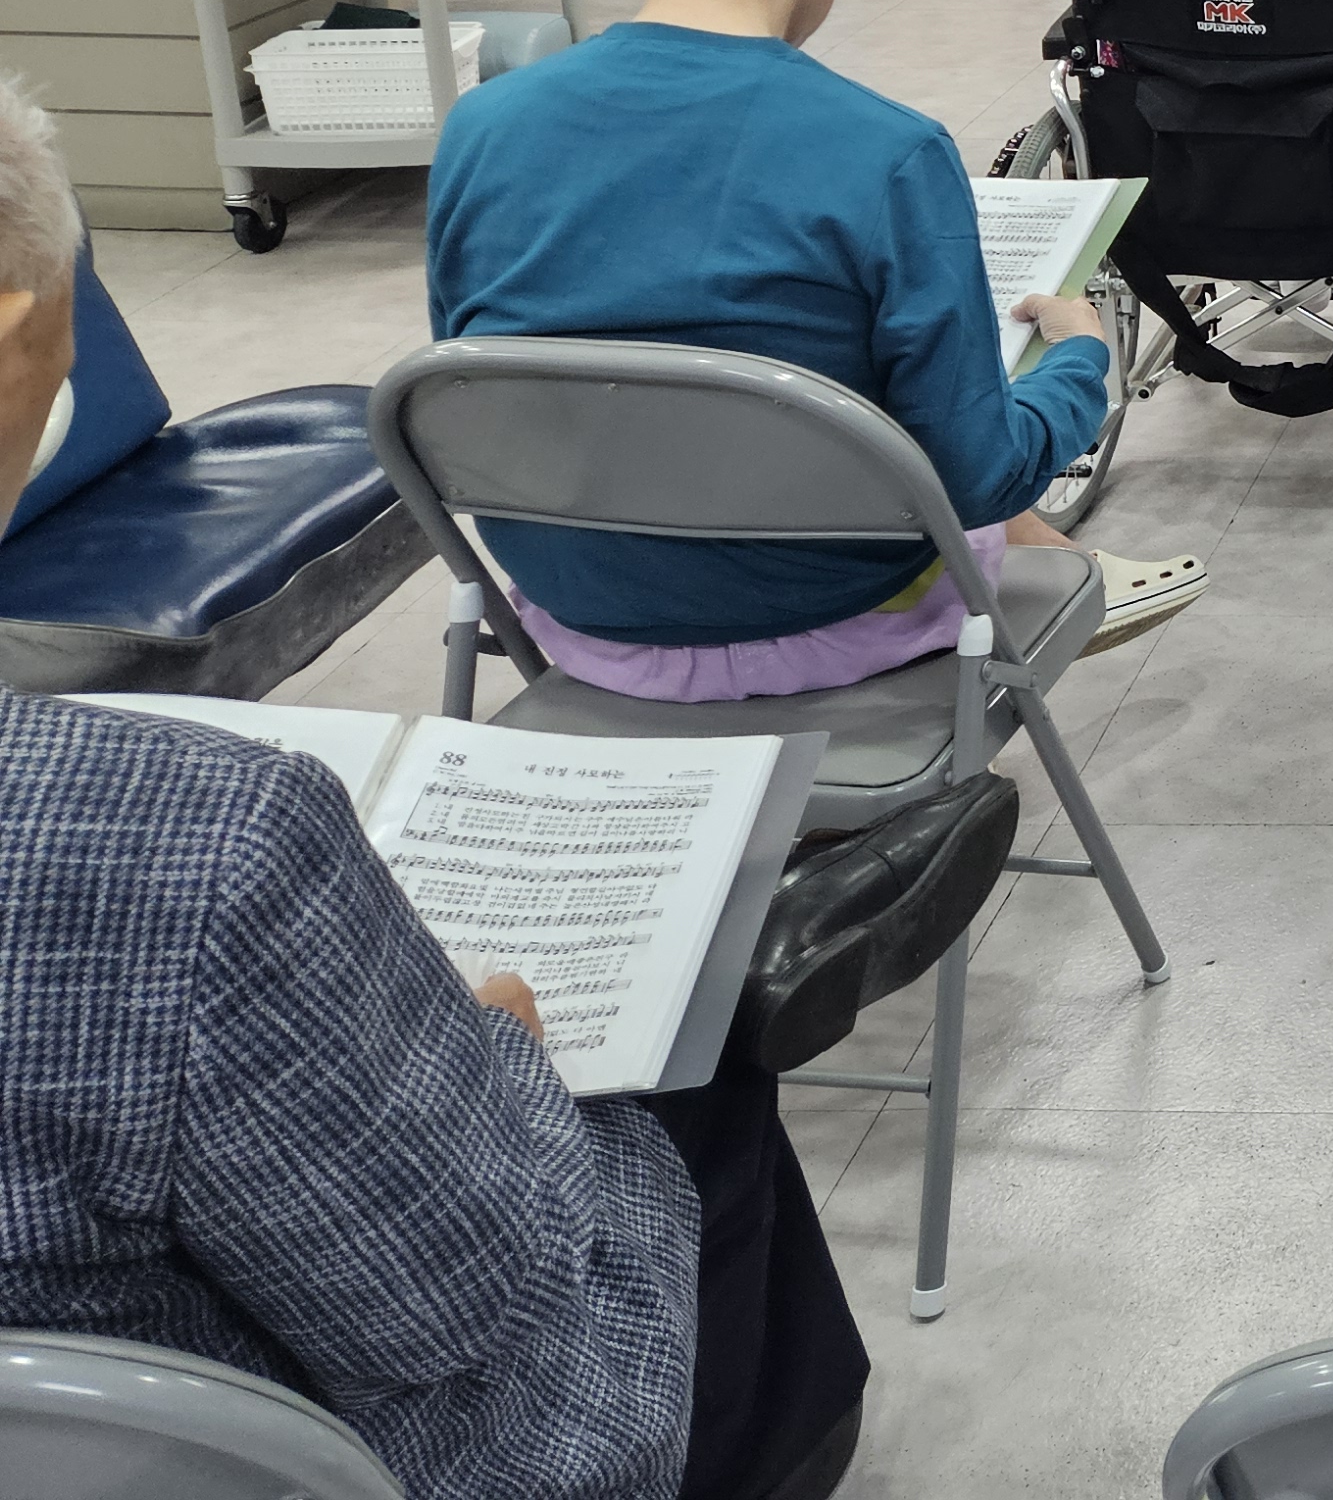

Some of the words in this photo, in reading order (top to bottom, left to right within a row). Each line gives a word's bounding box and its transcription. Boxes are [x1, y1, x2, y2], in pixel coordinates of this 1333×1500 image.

[1204, 1, 1255, 24] MK
[439, 751, 468, 767] 88
[524, 764, 536, 774] 내
[544, 765, 568, 777] 진정
[575, 768, 626, 779] 사모하는
